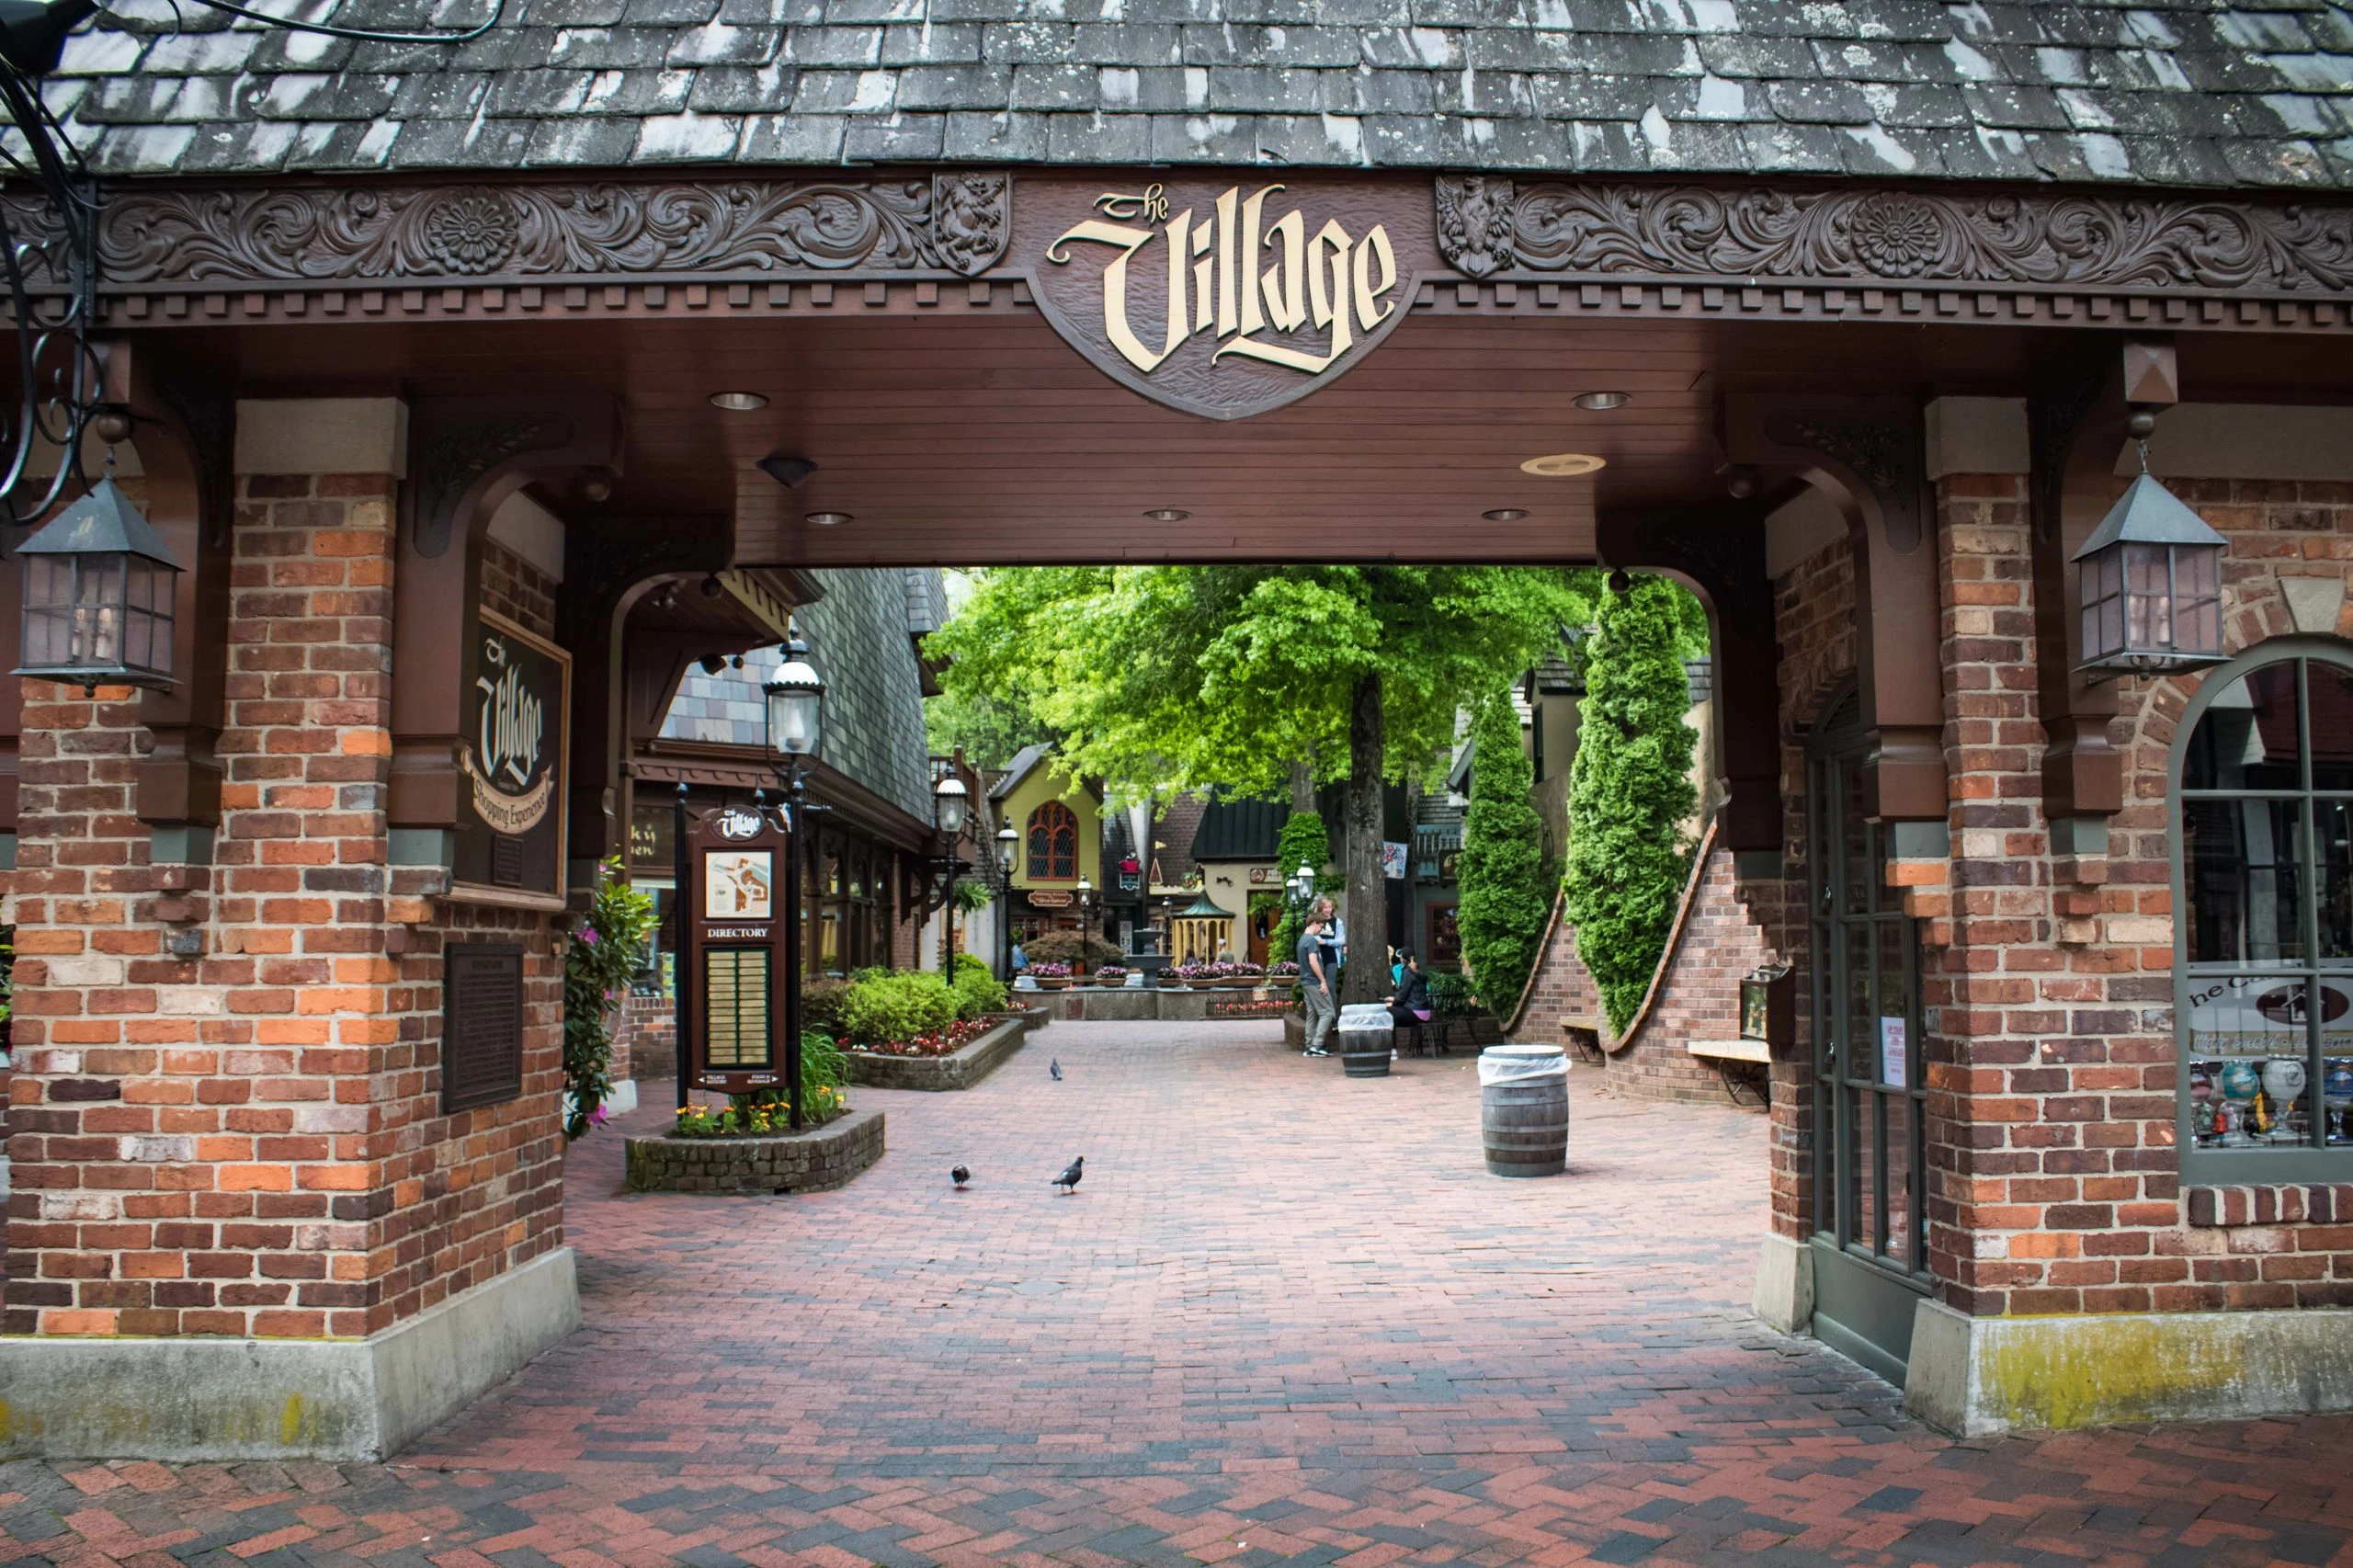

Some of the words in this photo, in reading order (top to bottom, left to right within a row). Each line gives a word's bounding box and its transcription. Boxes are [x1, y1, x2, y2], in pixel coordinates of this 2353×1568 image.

[1092, 183, 1169, 223] The
[1045, 184, 1397, 374] Village
[476, 663, 543, 787] Village
[475, 779, 509, 829] Shopping
[510, 792, 546, 828] Experience
[716, 812, 761, 838] Village
[708, 928, 768, 937] DIRECTORY
